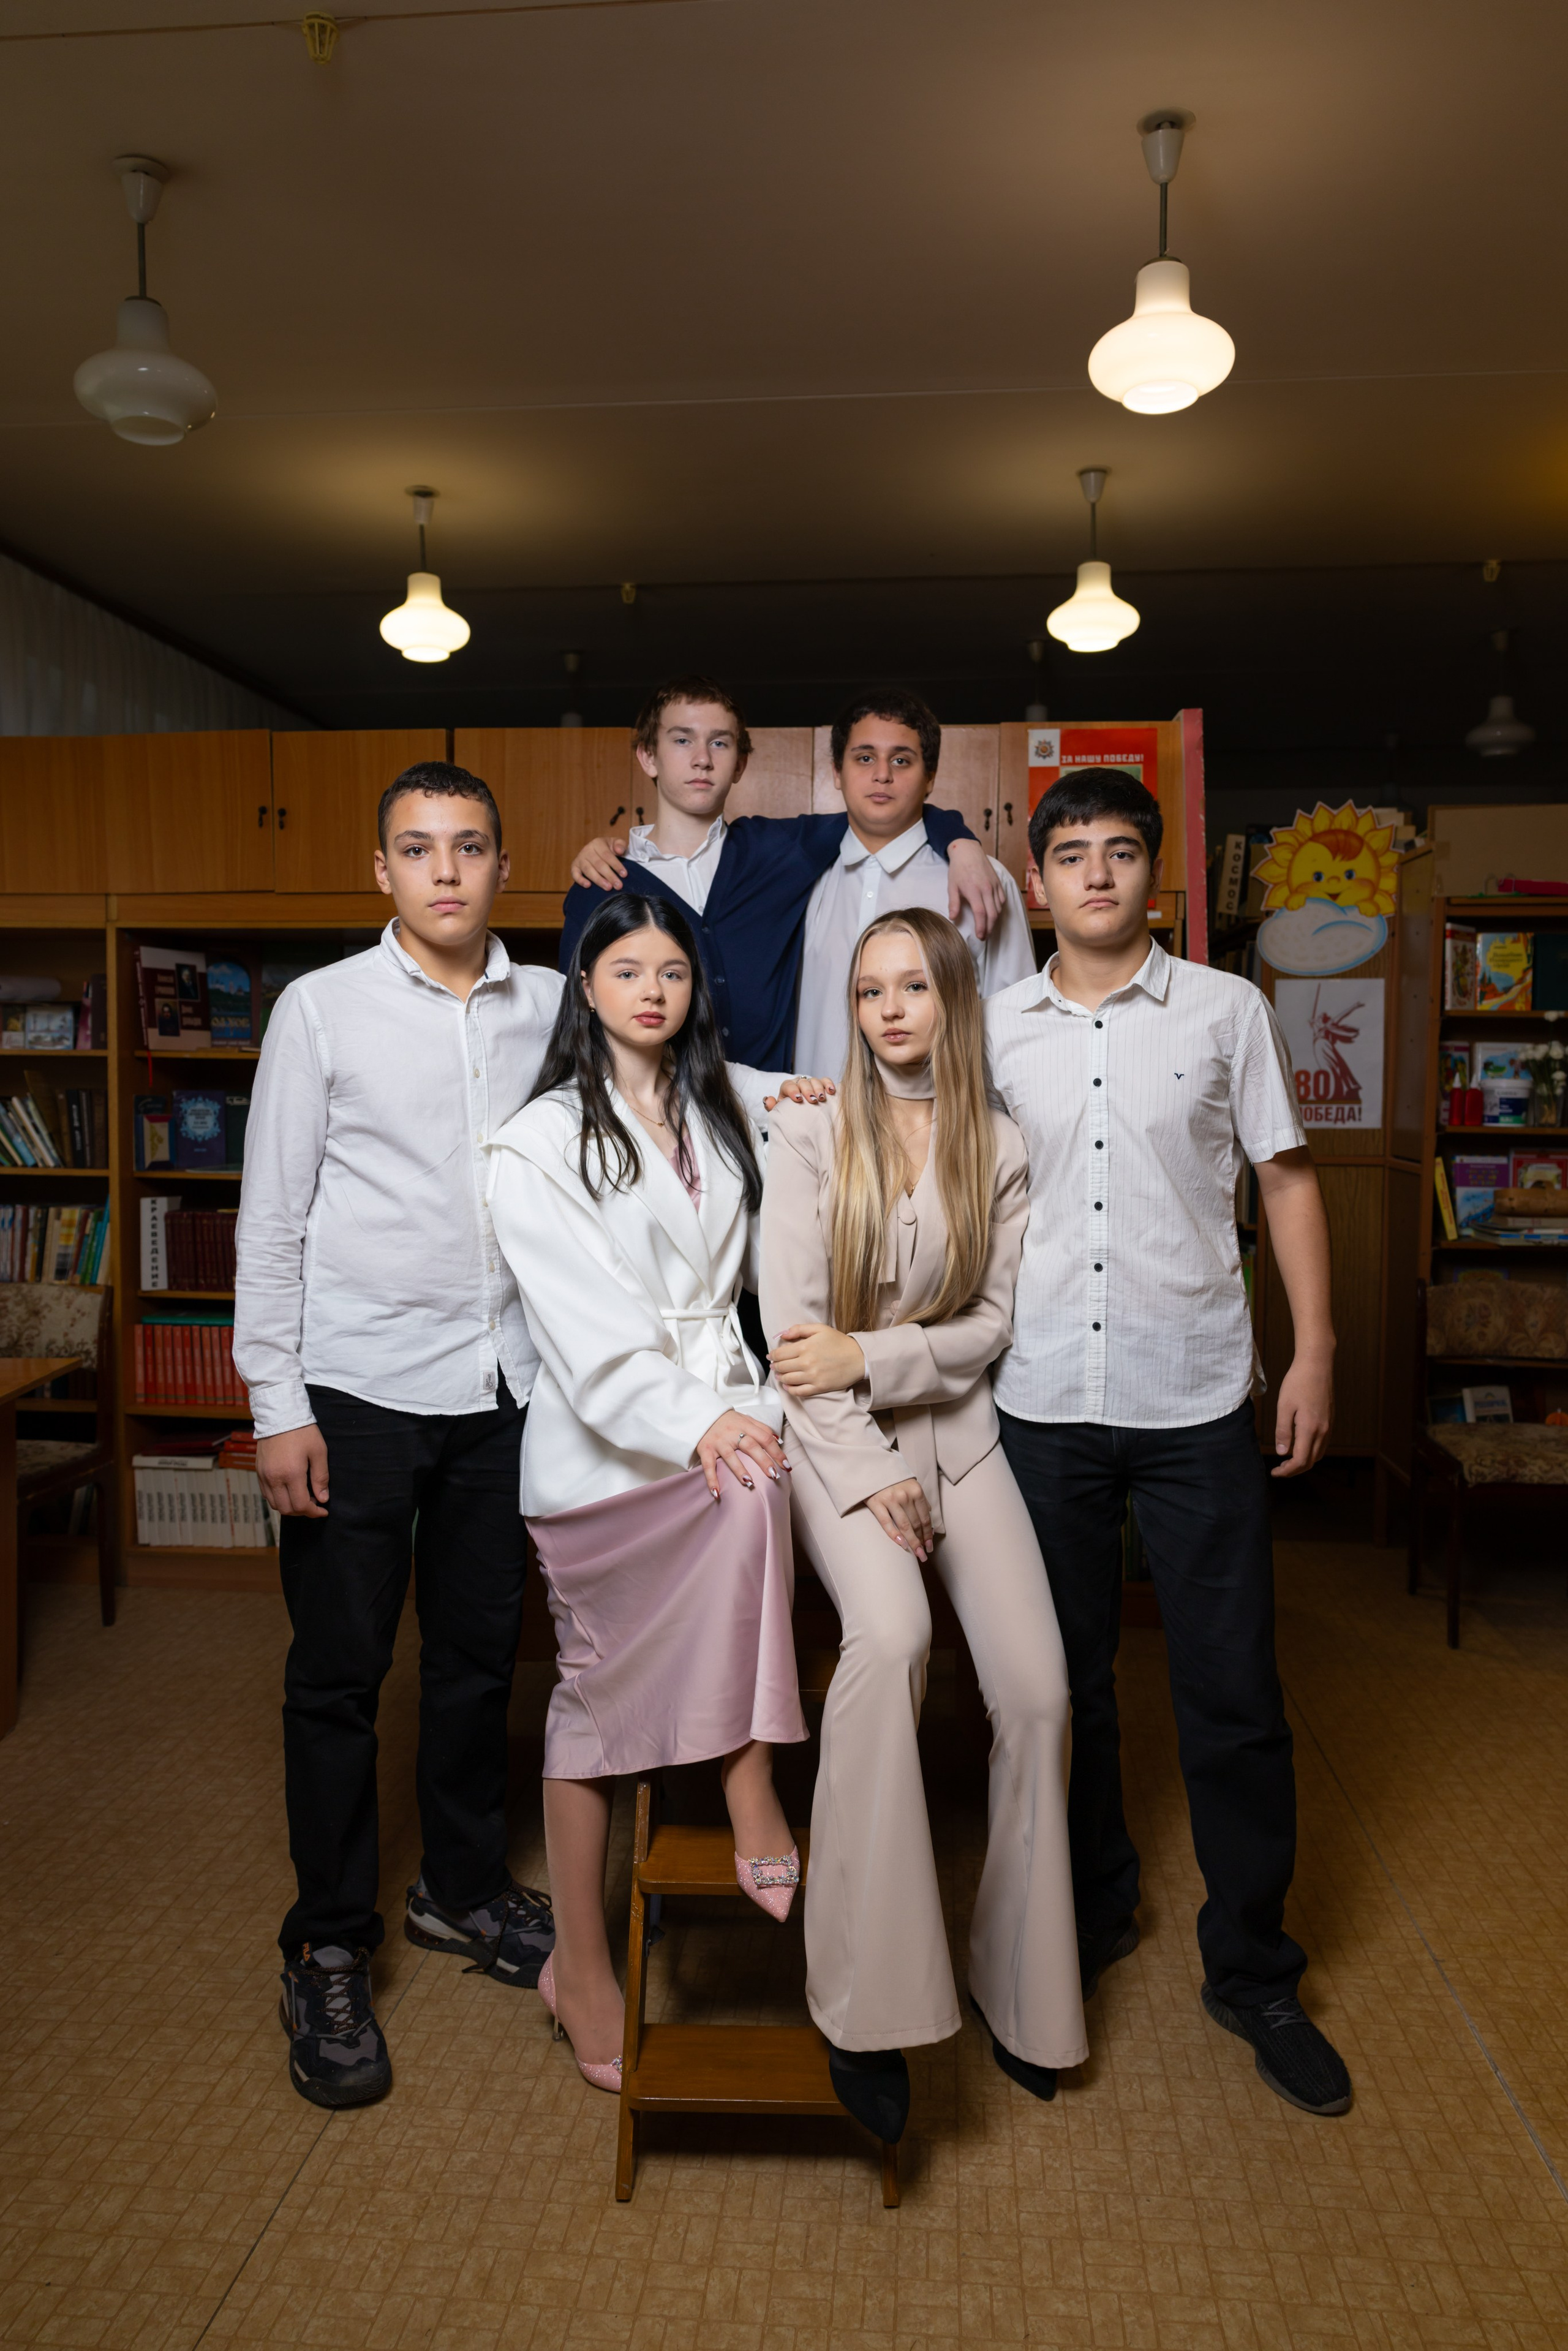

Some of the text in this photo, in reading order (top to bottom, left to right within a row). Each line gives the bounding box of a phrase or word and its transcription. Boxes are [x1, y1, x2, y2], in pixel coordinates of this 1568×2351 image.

[1061, 753, 1144, 764] ЗА НАШУ ПОБЕДУ!
[1226, 840, 1242, 911] КОСМОС
[1294, 1069, 1330, 1101] 80
[150, 1199, 159, 1288] КРАЕВЕДЕНИЕ
[303, 1942, 311, 1961] FILA
